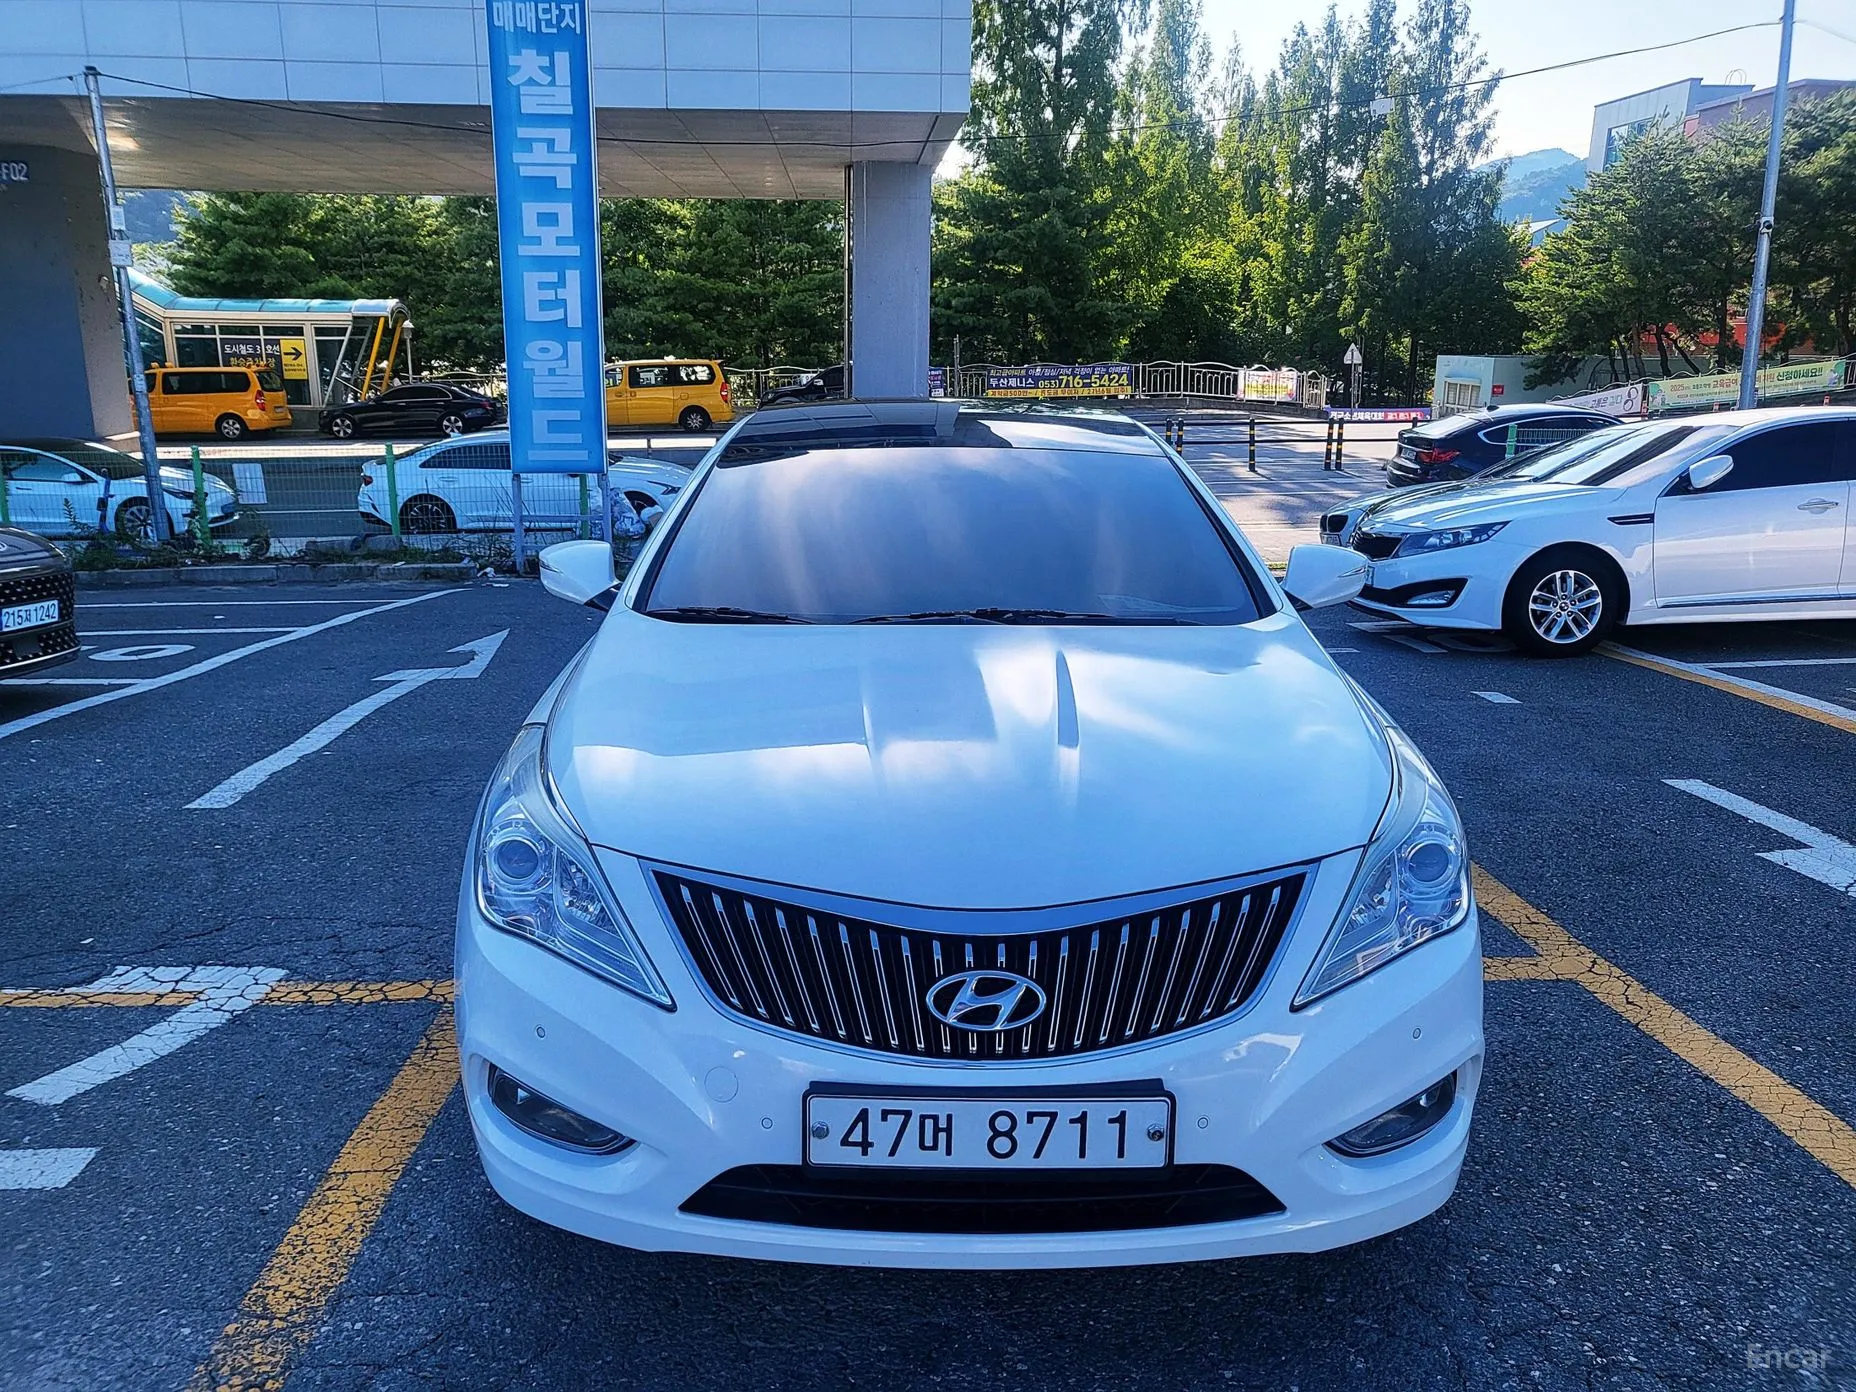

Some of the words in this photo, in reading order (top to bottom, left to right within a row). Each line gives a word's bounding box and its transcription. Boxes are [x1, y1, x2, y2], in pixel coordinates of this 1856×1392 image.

[492, 1, 580, 34] 매매단지
[507, 48, 589, 461] 칠곡모터월드
[224, 343, 255, 355] 도시철도
[990, 378, 1035, 387] 두산제니스
[1776, 367, 1823, 382] 신청하세요!!
[34, 603, 57, 622] 1242
[839, 1107, 953, 1158] 47머
[986, 1110, 1128, 1160] 8711
